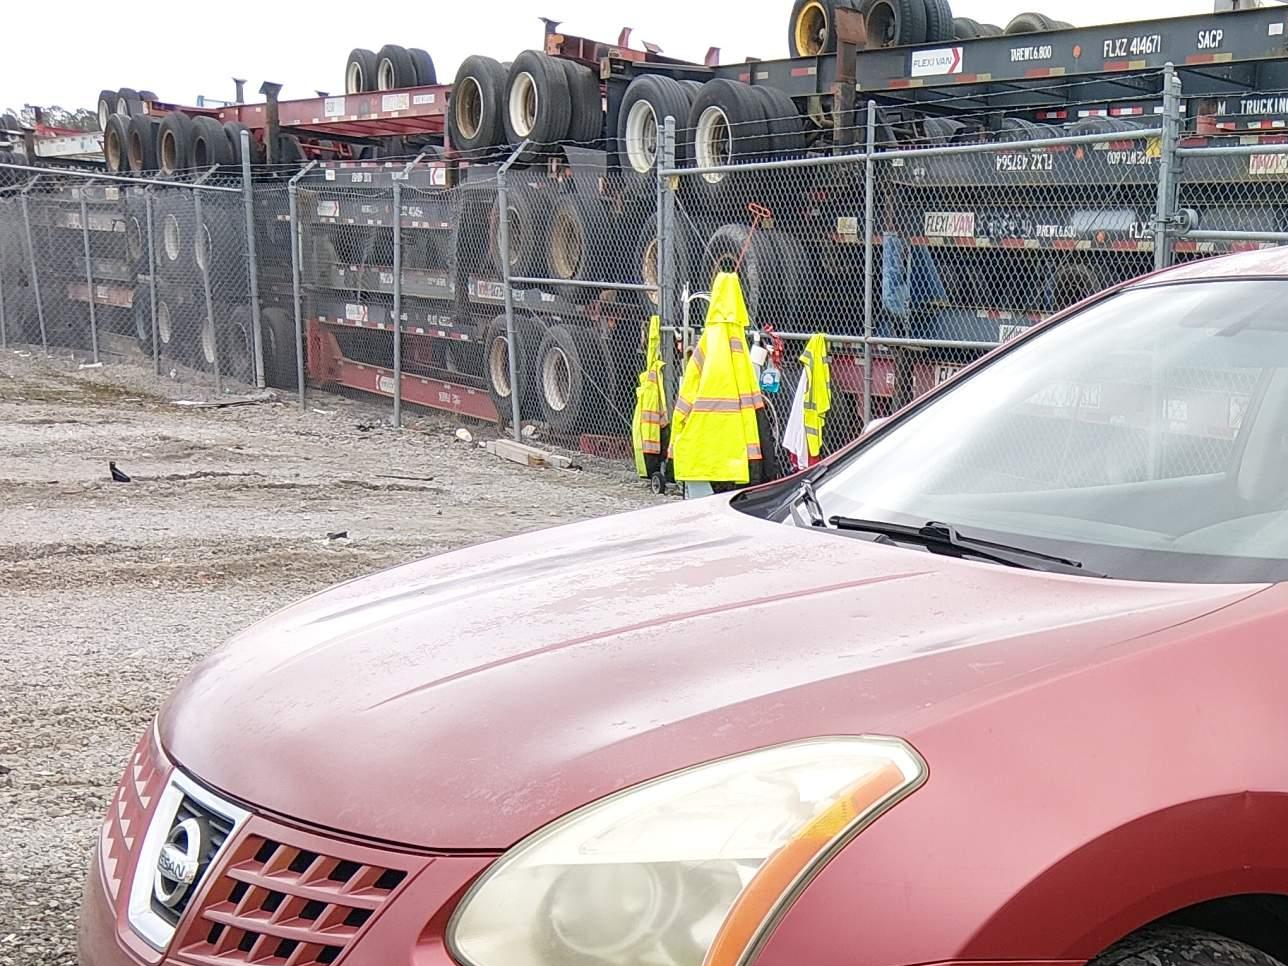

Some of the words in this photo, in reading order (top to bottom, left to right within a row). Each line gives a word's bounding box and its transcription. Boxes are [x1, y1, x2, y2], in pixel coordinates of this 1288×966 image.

[1103, 38, 1127, 58] FLXZ
[1130, 35, 1161, 56] 414671
[1198, 29, 1223, 49] SACP
